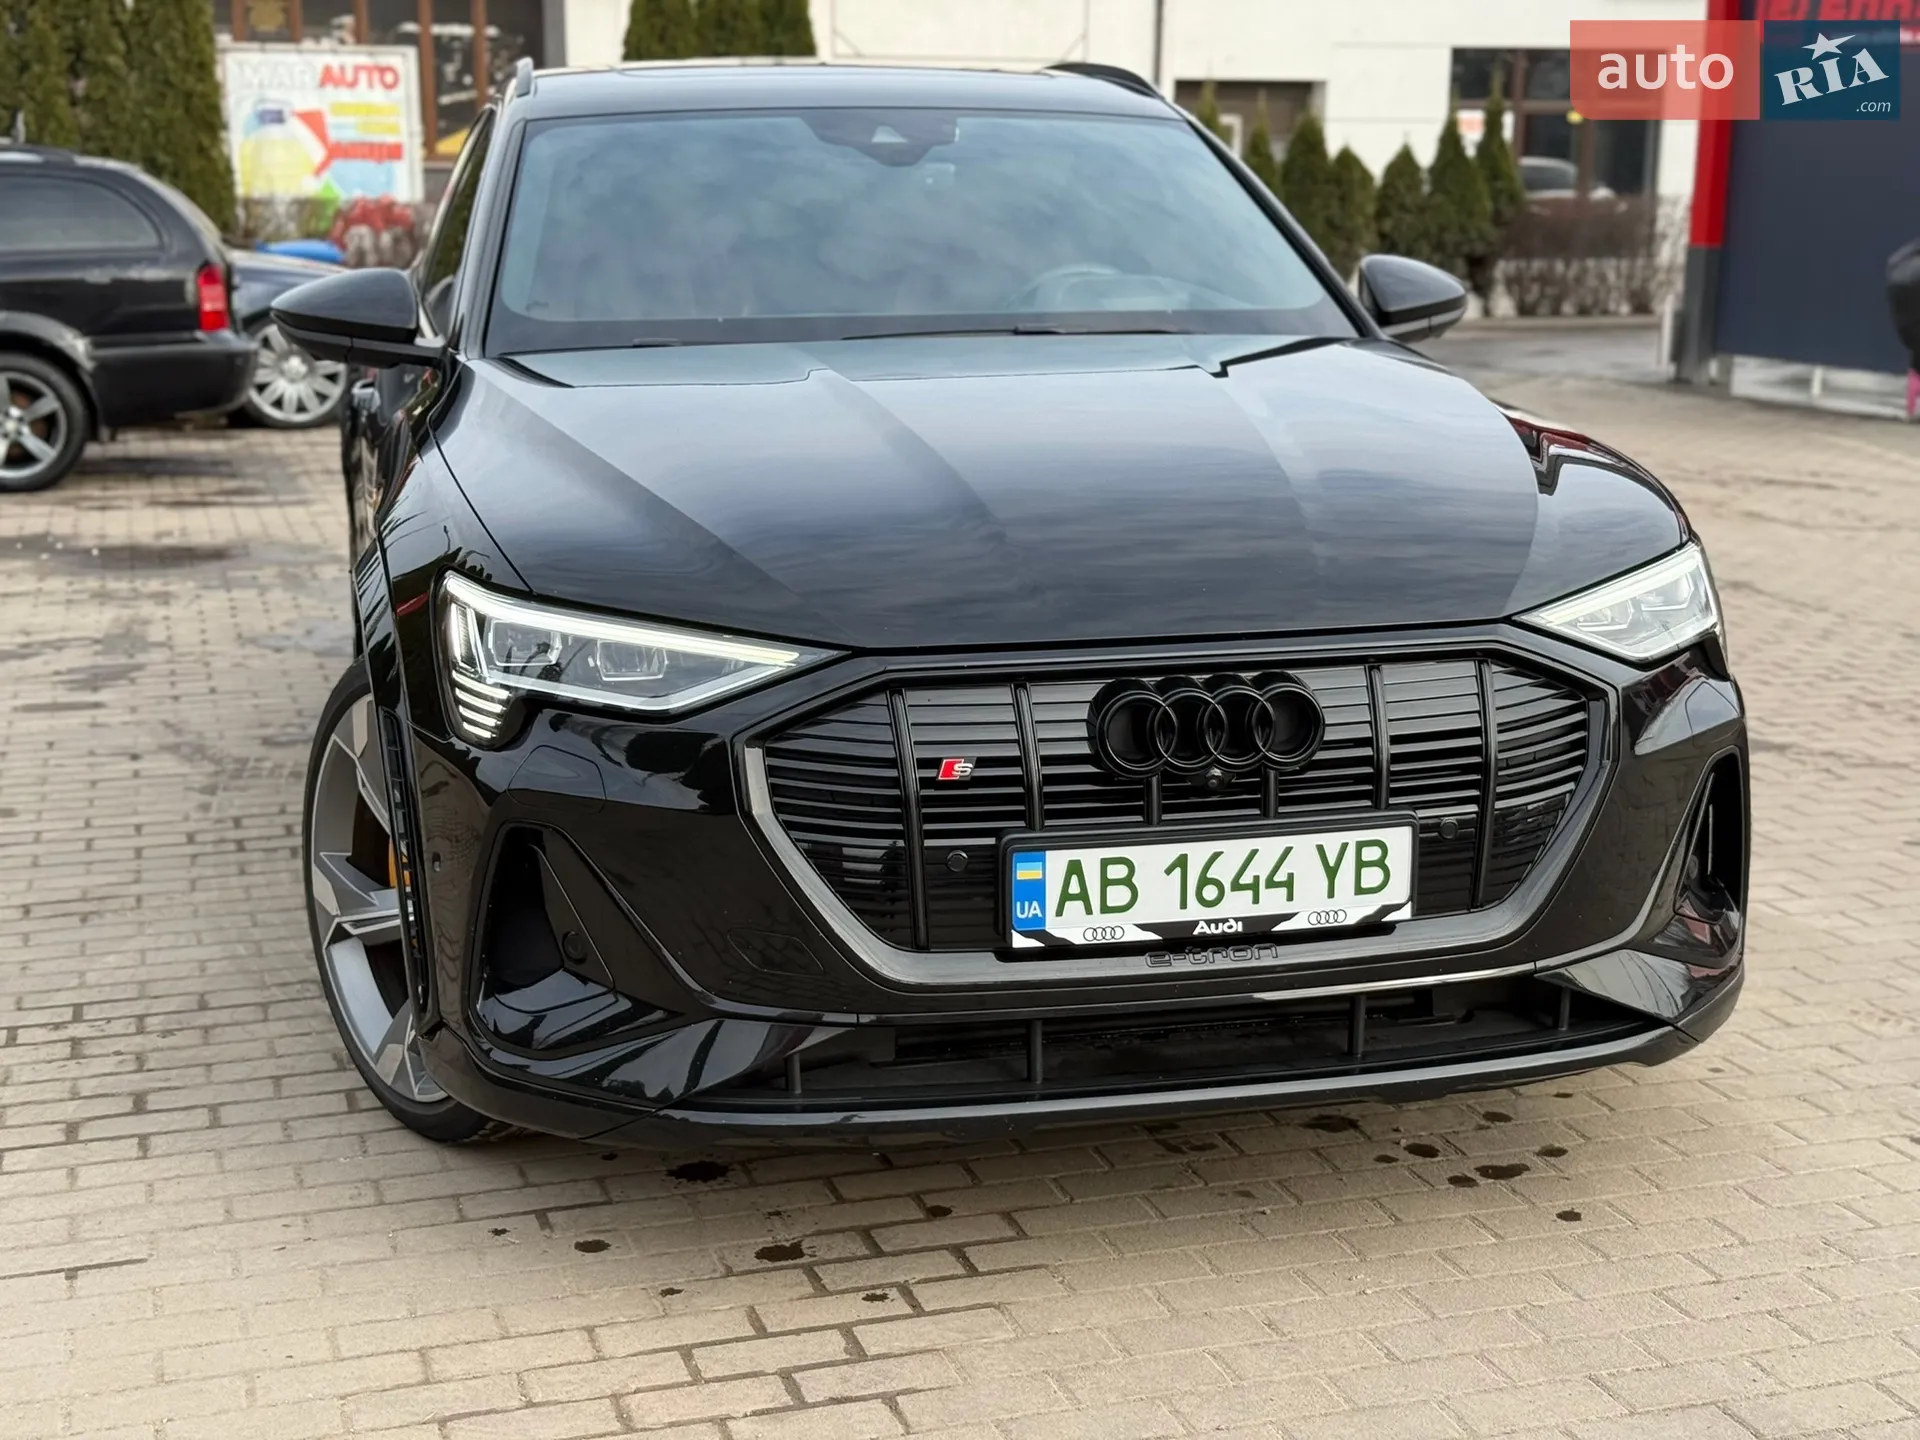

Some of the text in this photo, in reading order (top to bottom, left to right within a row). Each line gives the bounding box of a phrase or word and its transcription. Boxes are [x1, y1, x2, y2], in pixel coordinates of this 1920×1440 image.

[319, 64, 400, 90] AUTO
[1055, 838, 1391, 918] AB 1644 YB
[1016, 900, 1043, 919] UA
[1192, 919, 1243, 936] Audi
[1145, 943, 1279, 968] e-tron
